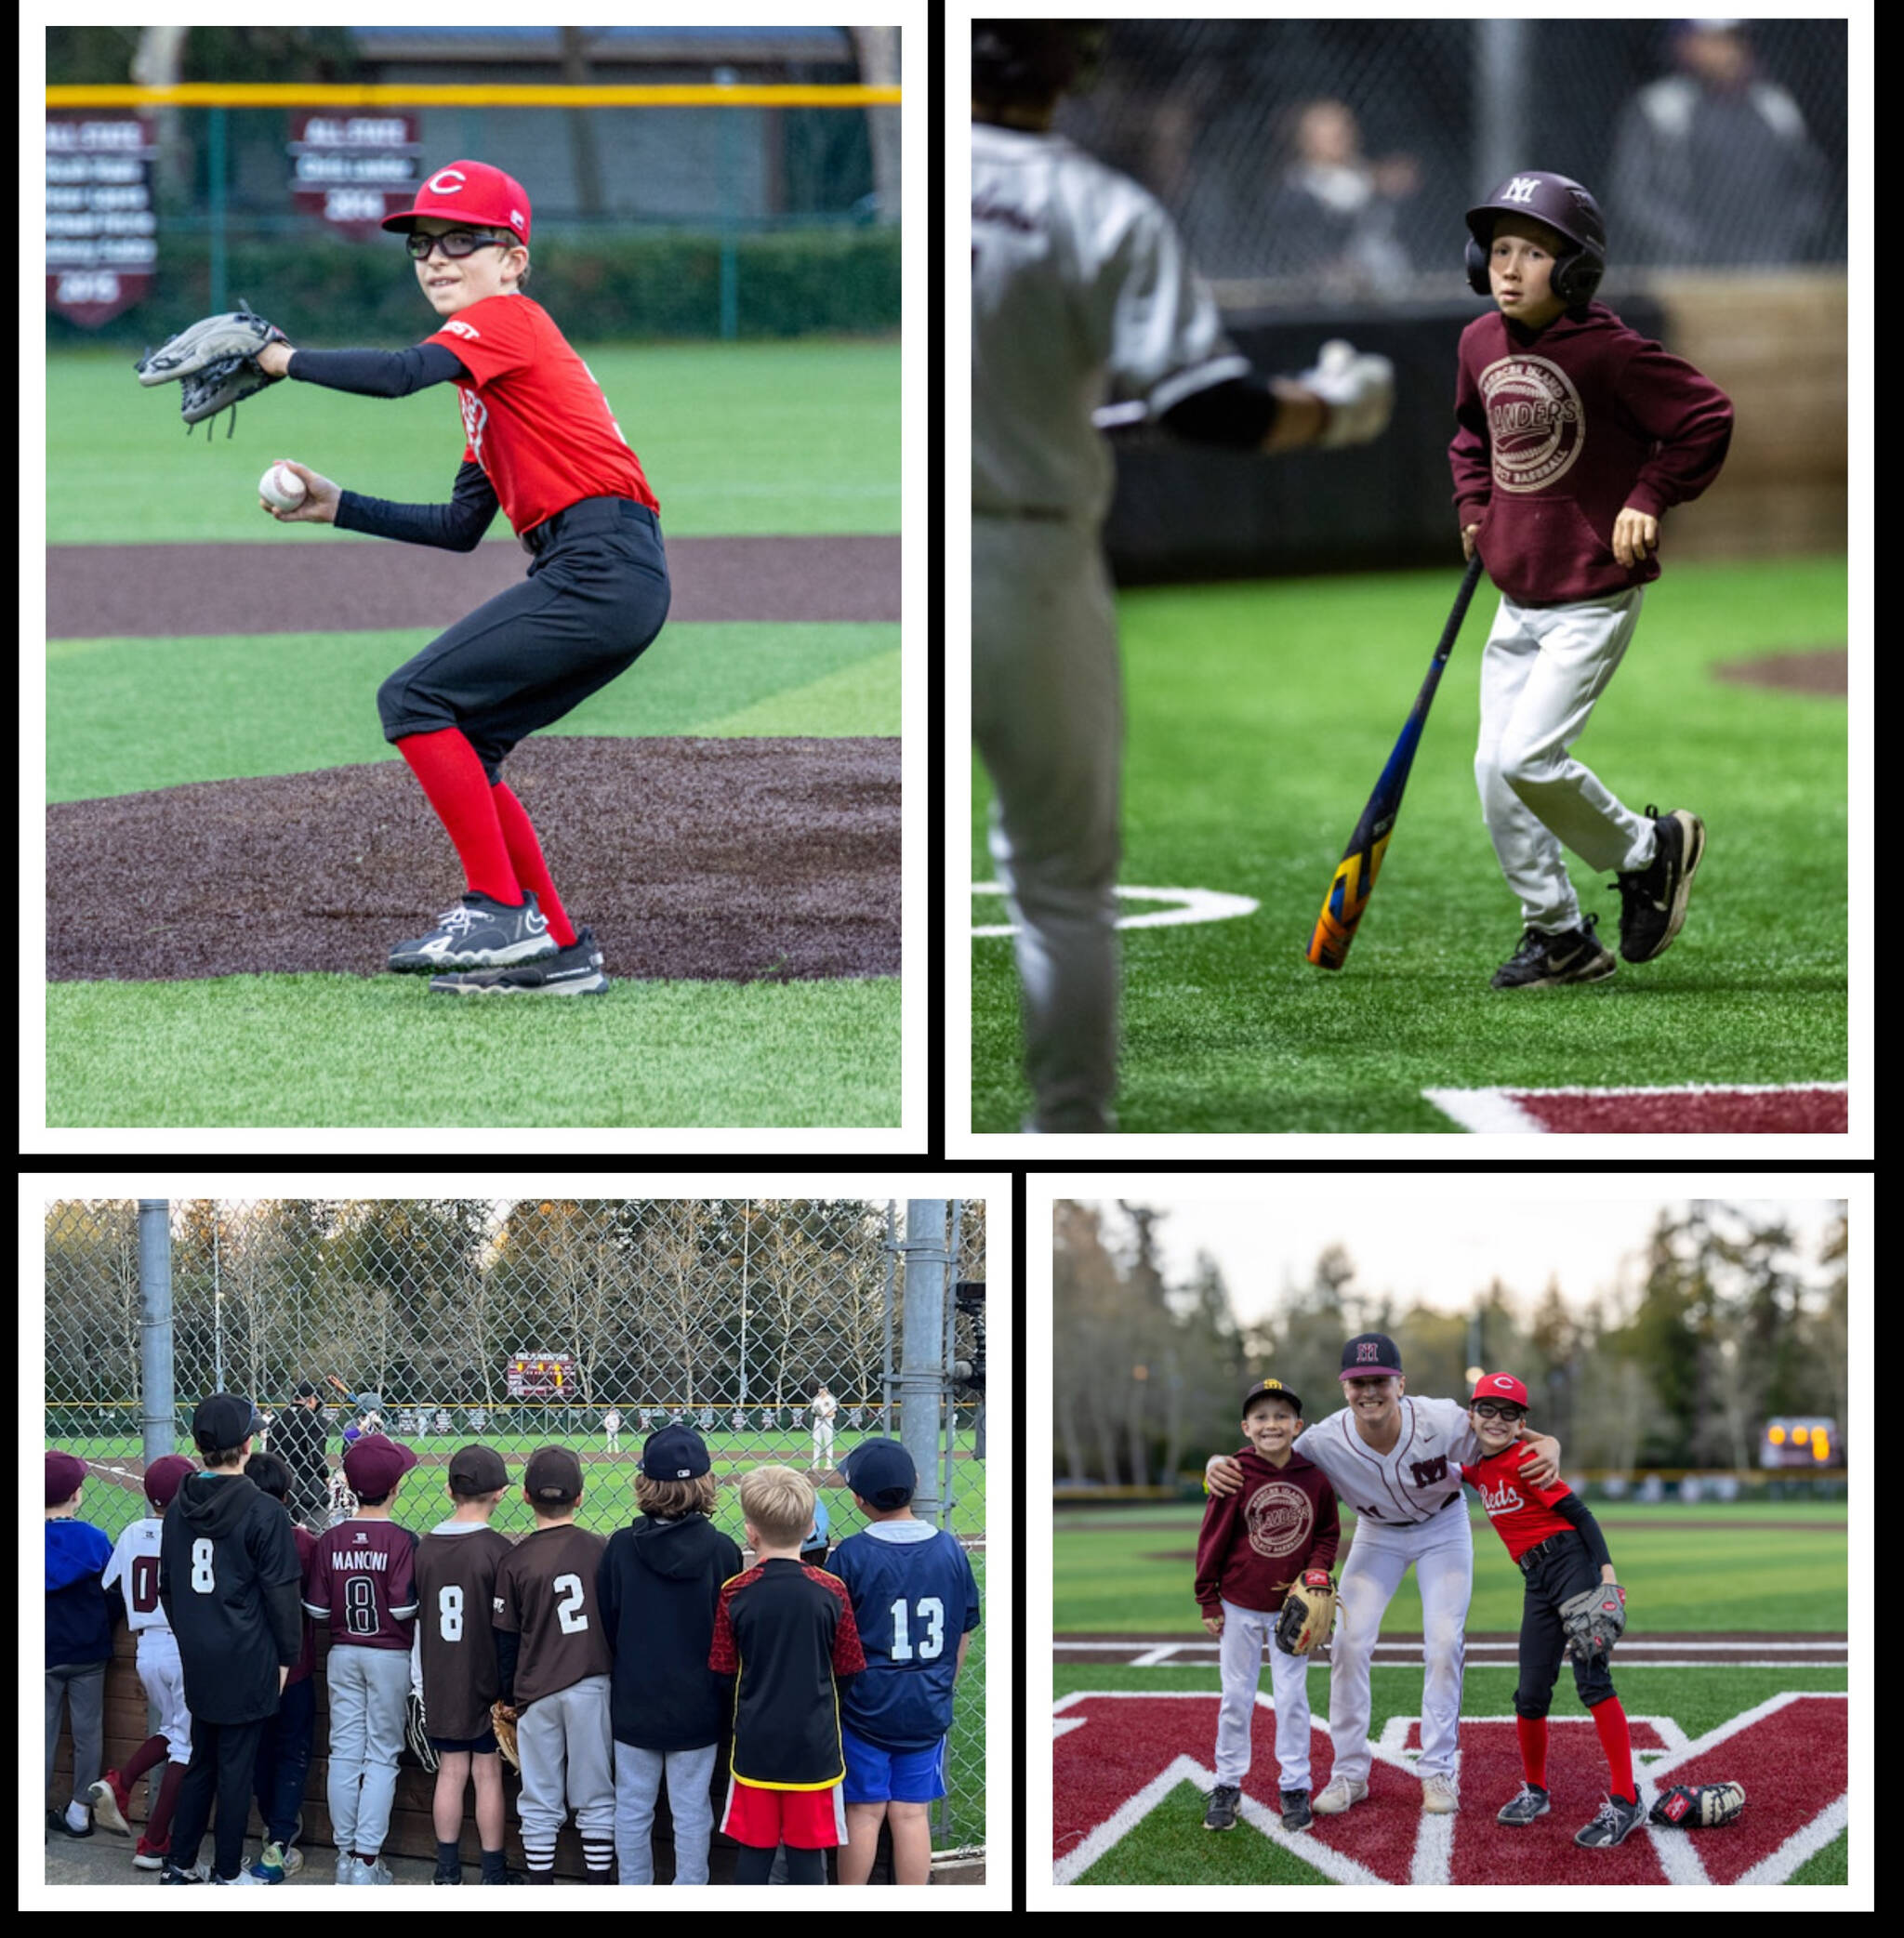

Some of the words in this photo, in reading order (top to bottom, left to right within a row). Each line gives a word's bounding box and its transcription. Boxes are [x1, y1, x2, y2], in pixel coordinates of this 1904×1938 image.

[429, 170, 466, 195] C
[1493, 1377, 1514, 1390] C
[1479, 1479, 1524, 1516] Reds
[132, 1555, 160, 1613] 0
[191, 1537, 215, 1594] 8
[332, 1550, 388, 1571] MANCINI
[346, 1575, 379, 1636] 8
[439, 1585, 463, 1641] 8
[553, 1573, 588, 1635] 2
[890, 1597, 945, 1660] 13
